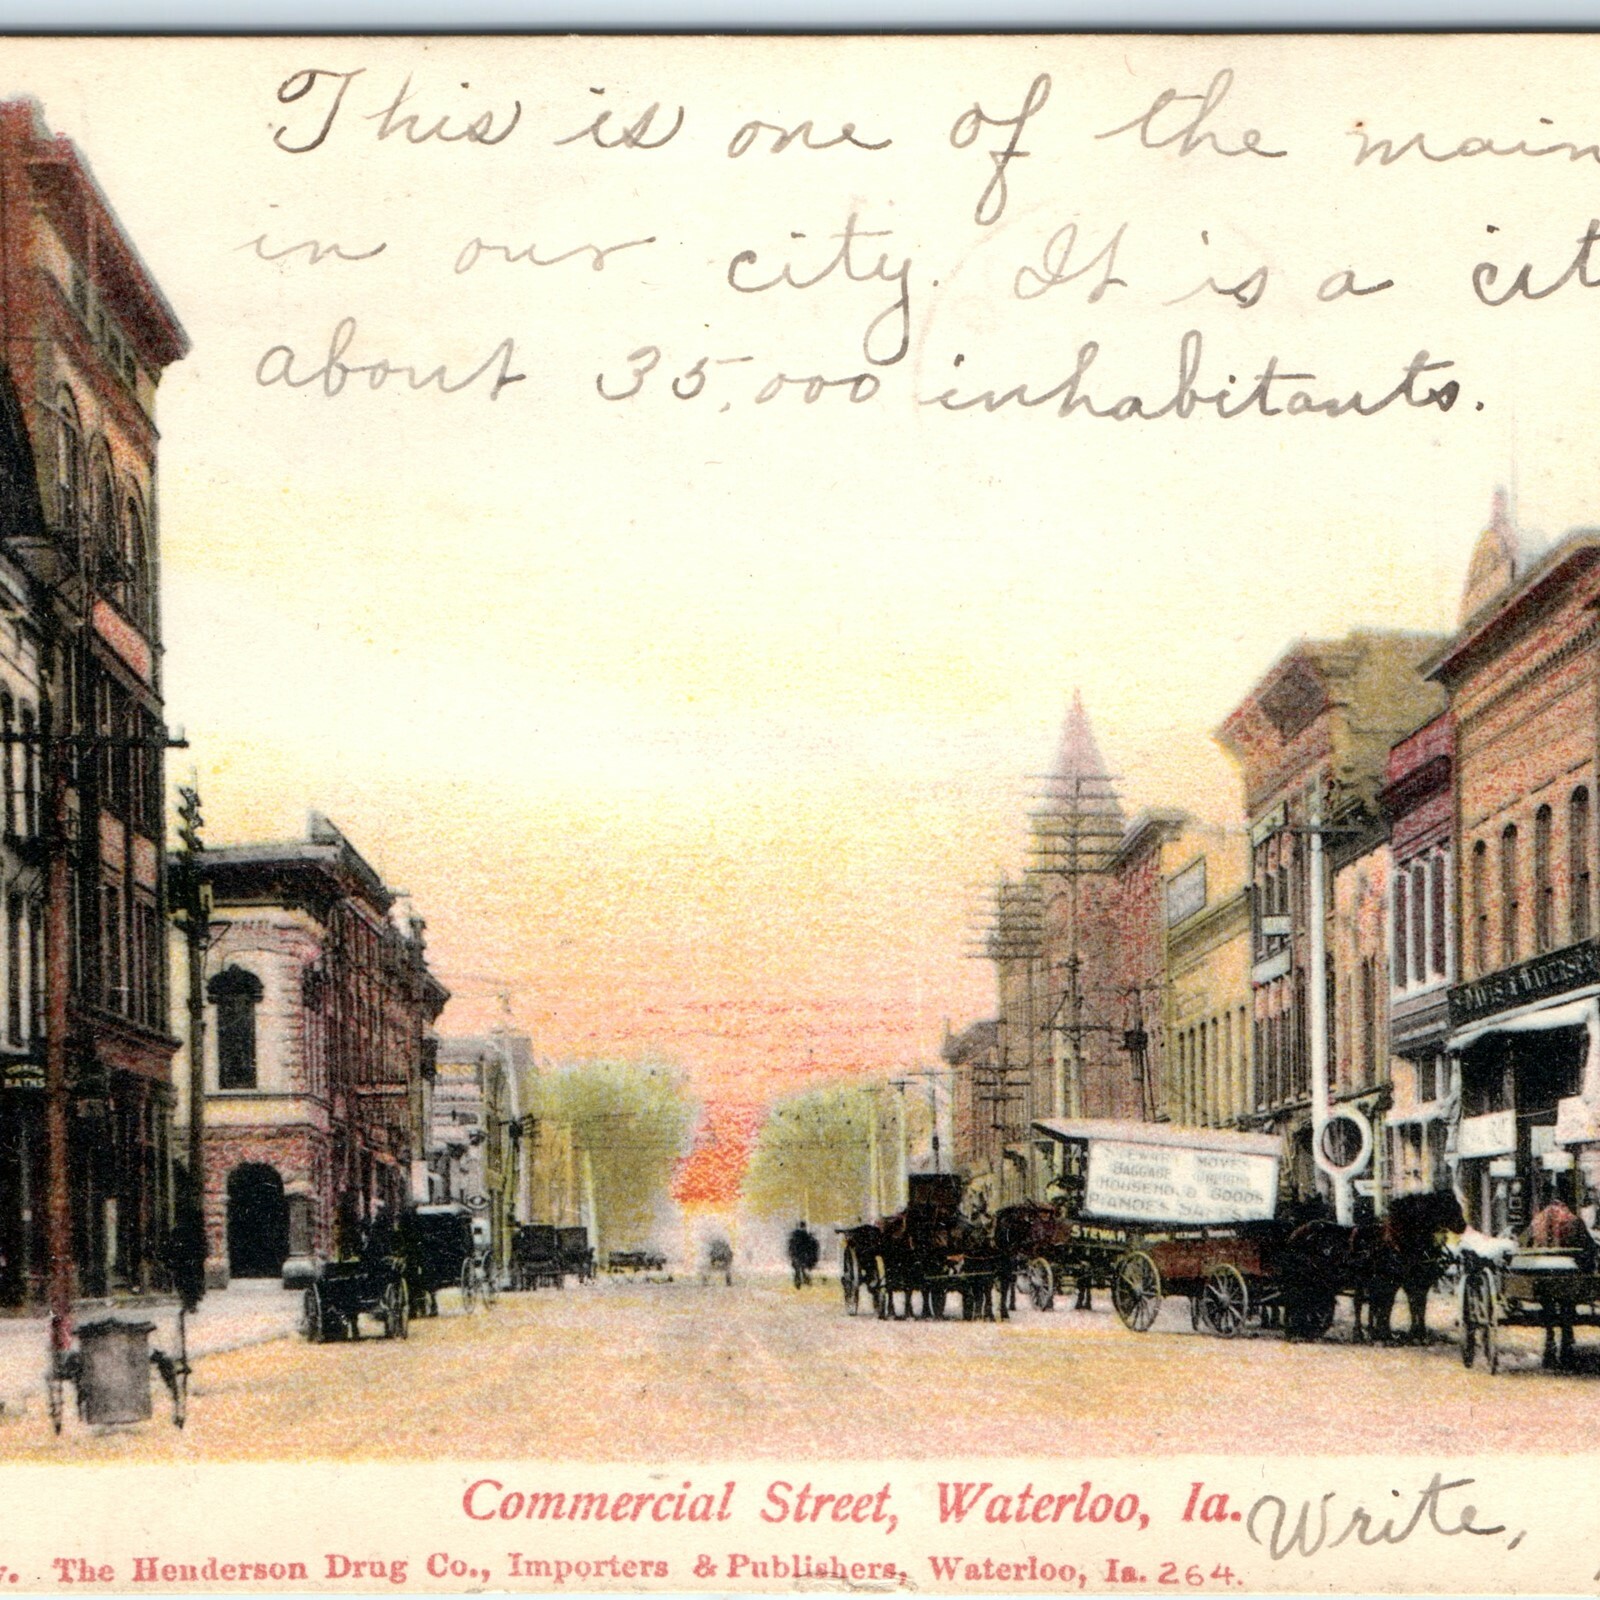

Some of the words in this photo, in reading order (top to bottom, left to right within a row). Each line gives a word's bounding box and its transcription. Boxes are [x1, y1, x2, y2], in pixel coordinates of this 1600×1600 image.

[273, 67, 522, 154] This
[554, 87, 684, 150] is
[728, 119, 892, 159] one
[950, 73, 1051, 226] of
[1095, 69, 1288, 159] the
[240, 204, 388, 264] in
[455, 236, 656, 274] our
[1014, 223, 1128, 304] It
[1165, 230, 1269, 309] is
[1317, 270, 1395, 302] a
[256, 317, 527, 402] about
